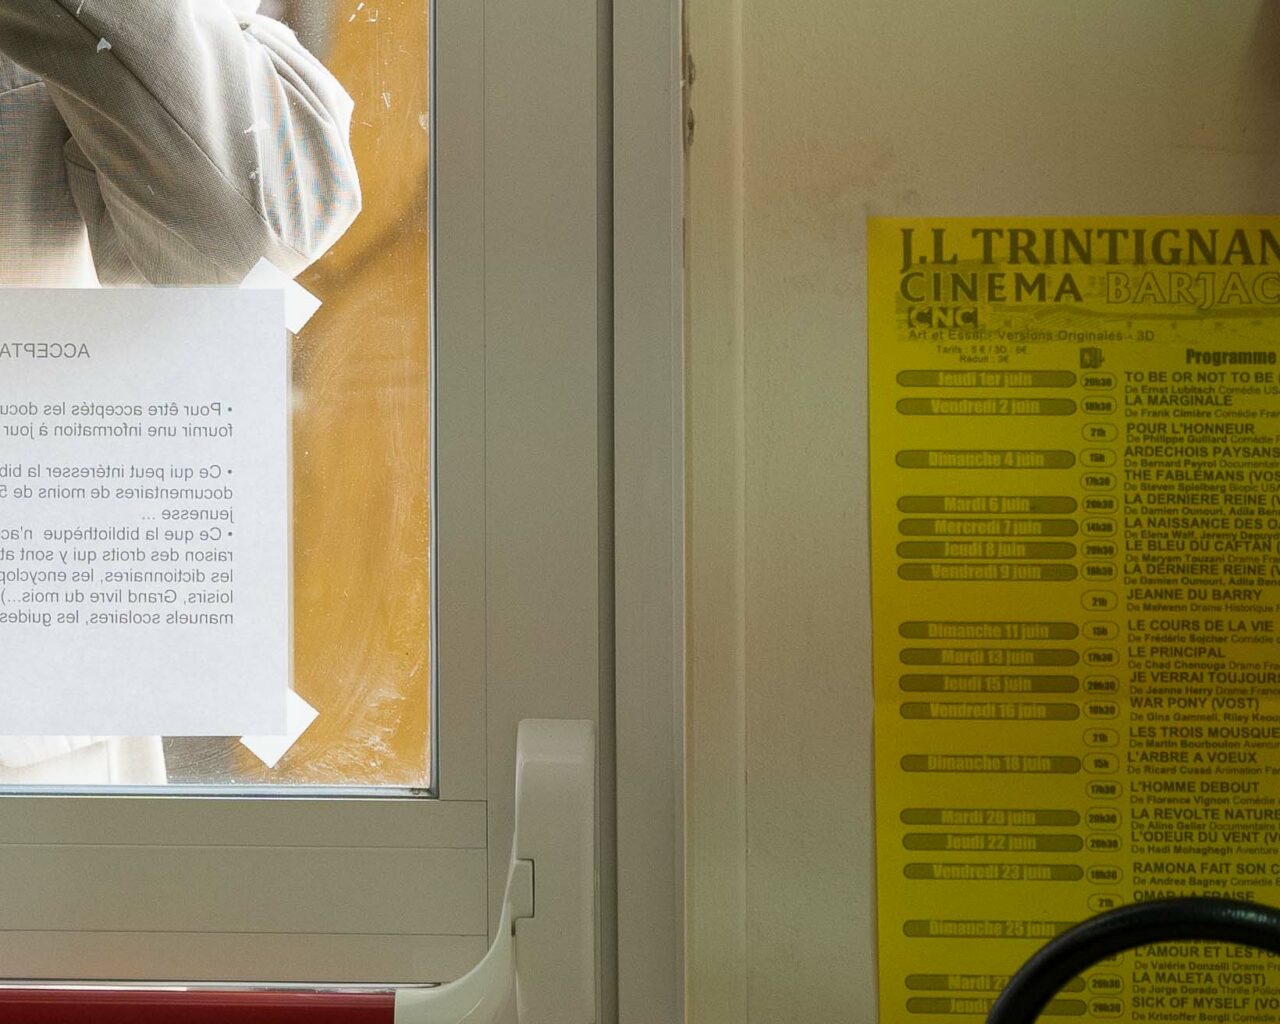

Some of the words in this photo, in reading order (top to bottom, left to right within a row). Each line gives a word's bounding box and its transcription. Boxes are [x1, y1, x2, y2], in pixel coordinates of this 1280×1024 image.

[899, 271, 1084, 303] CINEMA
[908, 307, 979, 329] CNC
[1186, 348, 1277, 366] Programme
[1125, 371, 1145, 383] TO
[1148, 371, 1169, 383] BE
[1171, 371, 1193, 383] OR
[1196, 371, 1227, 383] NOT
[1231, 371, 1252, 384] TO
[1254, 371, 1275, 384] BE
[1125, 395, 1143, 406] LA
[1147, 395, 1233, 406] MARGINALE
[1126, 423, 1167, 435] POUR
[1171, 423, 1255, 435] L'HONNEUR
[1124, 446, 1209, 457] ARDECHOIS
[1125, 470, 1153, 481] THE
[1127, 589, 1183, 600] JEANNE
[1188, 589, 1208, 600] DU
[1212, 589, 1262, 601] BARRY
[1128, 647, 1146, 658] LE
[1150, 647, 1226, 658] PRINCIPAL
[1130, 697, 1164, 708] WAR
[1167, 697, 1207, 708] PONY
[1211, 697, 1260, 711] (VOST)
[1128, 751, 1189, 763] L'ARBRE
[1193, 751, 1204, 763] A
[1207, 752, 1258, 763] VOEUX
[1131, 781, 1197, 793] L'HOMME
[1200, 781, 1260, 793] DEBOUT
